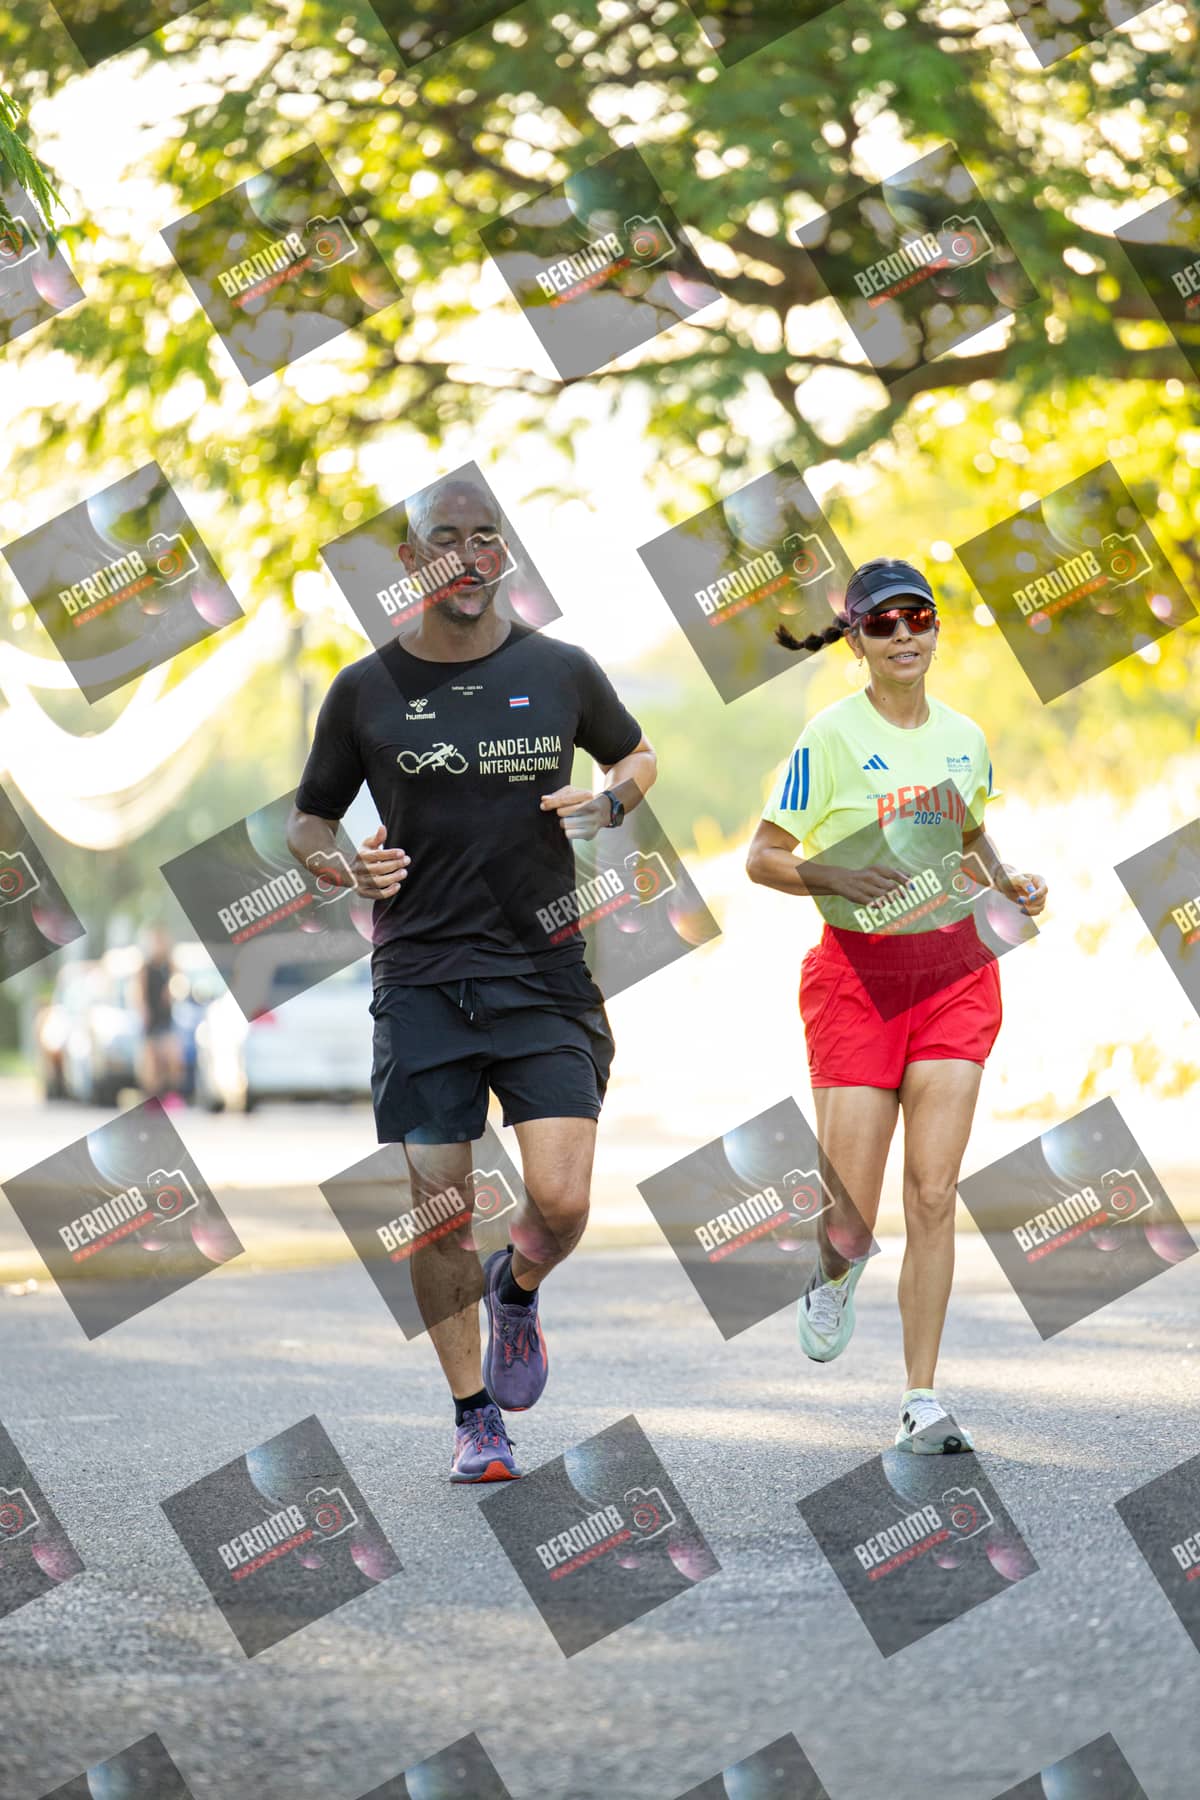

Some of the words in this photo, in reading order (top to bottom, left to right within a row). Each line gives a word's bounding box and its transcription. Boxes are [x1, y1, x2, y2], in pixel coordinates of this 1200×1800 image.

[406, 712, 436, 721] hummel
[478, 735, 562, 757] CANDELARIA
[479, 756, 560, 775] INTERNACIONAL
[877, 785, 966, 829] BERLIN
[914, 811, 942, 825] 2026
